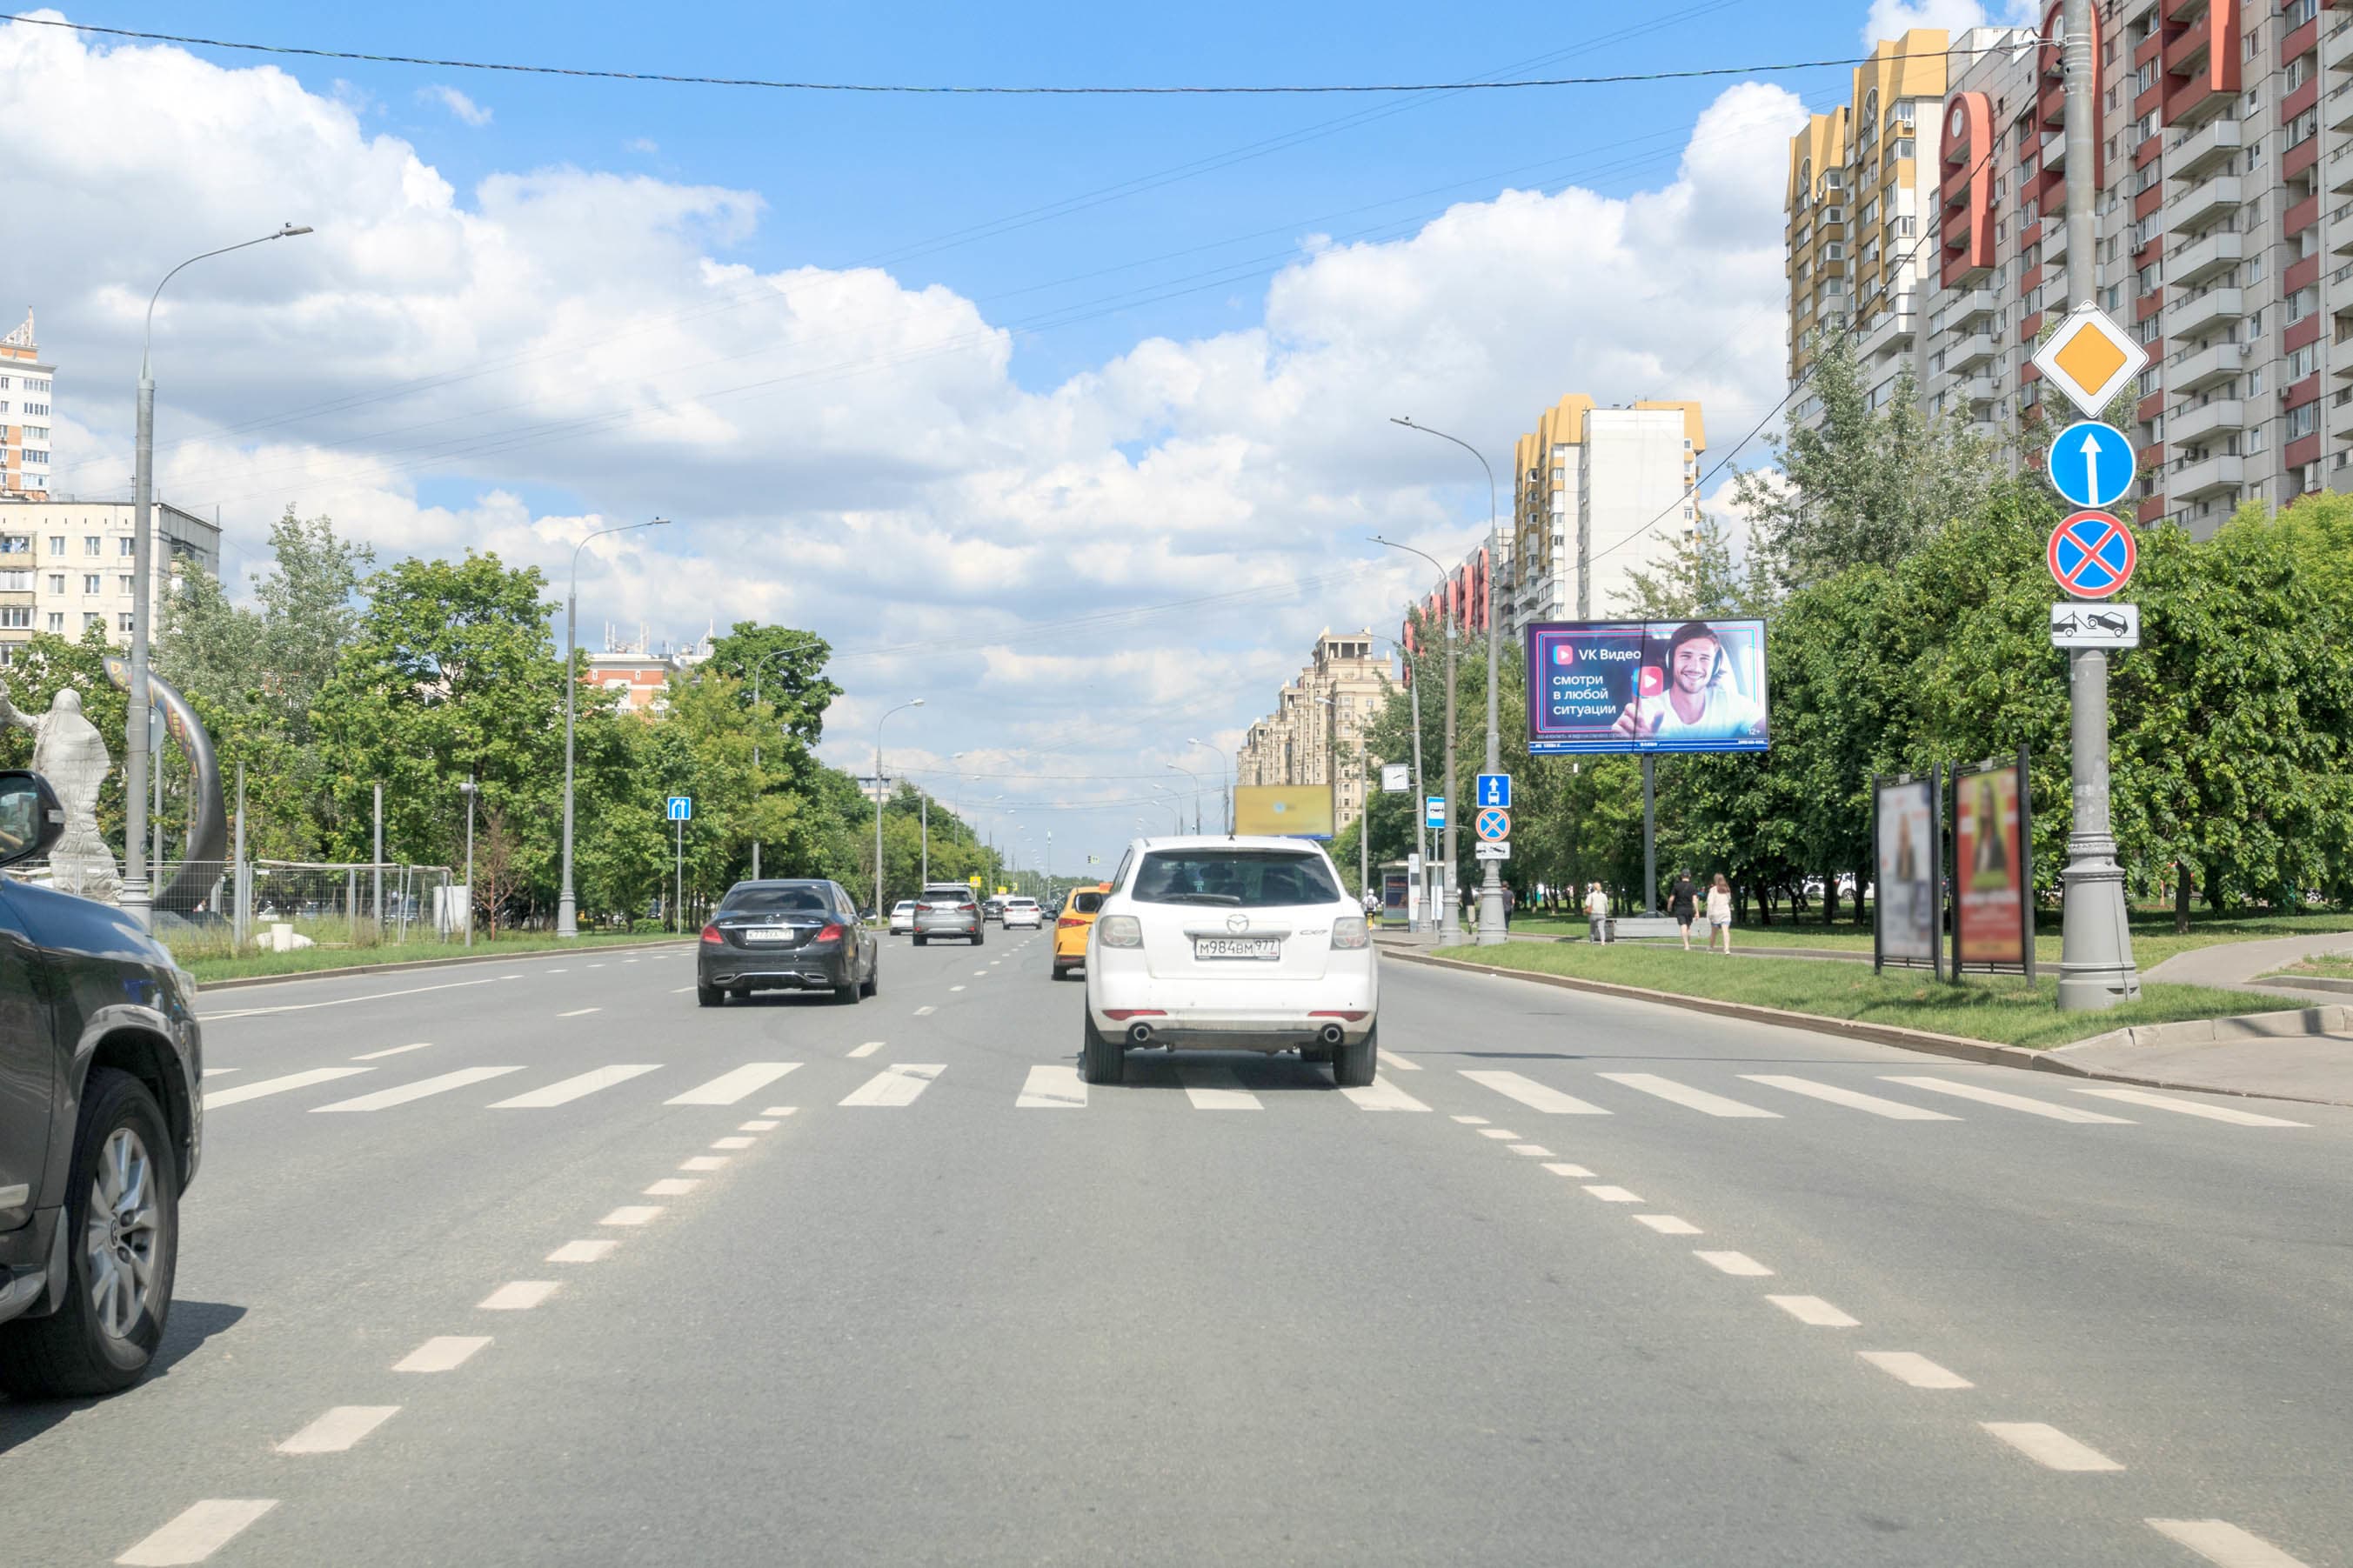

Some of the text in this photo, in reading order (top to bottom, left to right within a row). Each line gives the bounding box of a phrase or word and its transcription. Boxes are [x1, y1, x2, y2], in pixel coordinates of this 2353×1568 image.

[1578, 649, 1641, 661] VK Видео
[1553, 676, 1603, 687] смотри
[1553, 688, 1608, 700] в любой
[1553, 704, 1616, 717] ситуации
